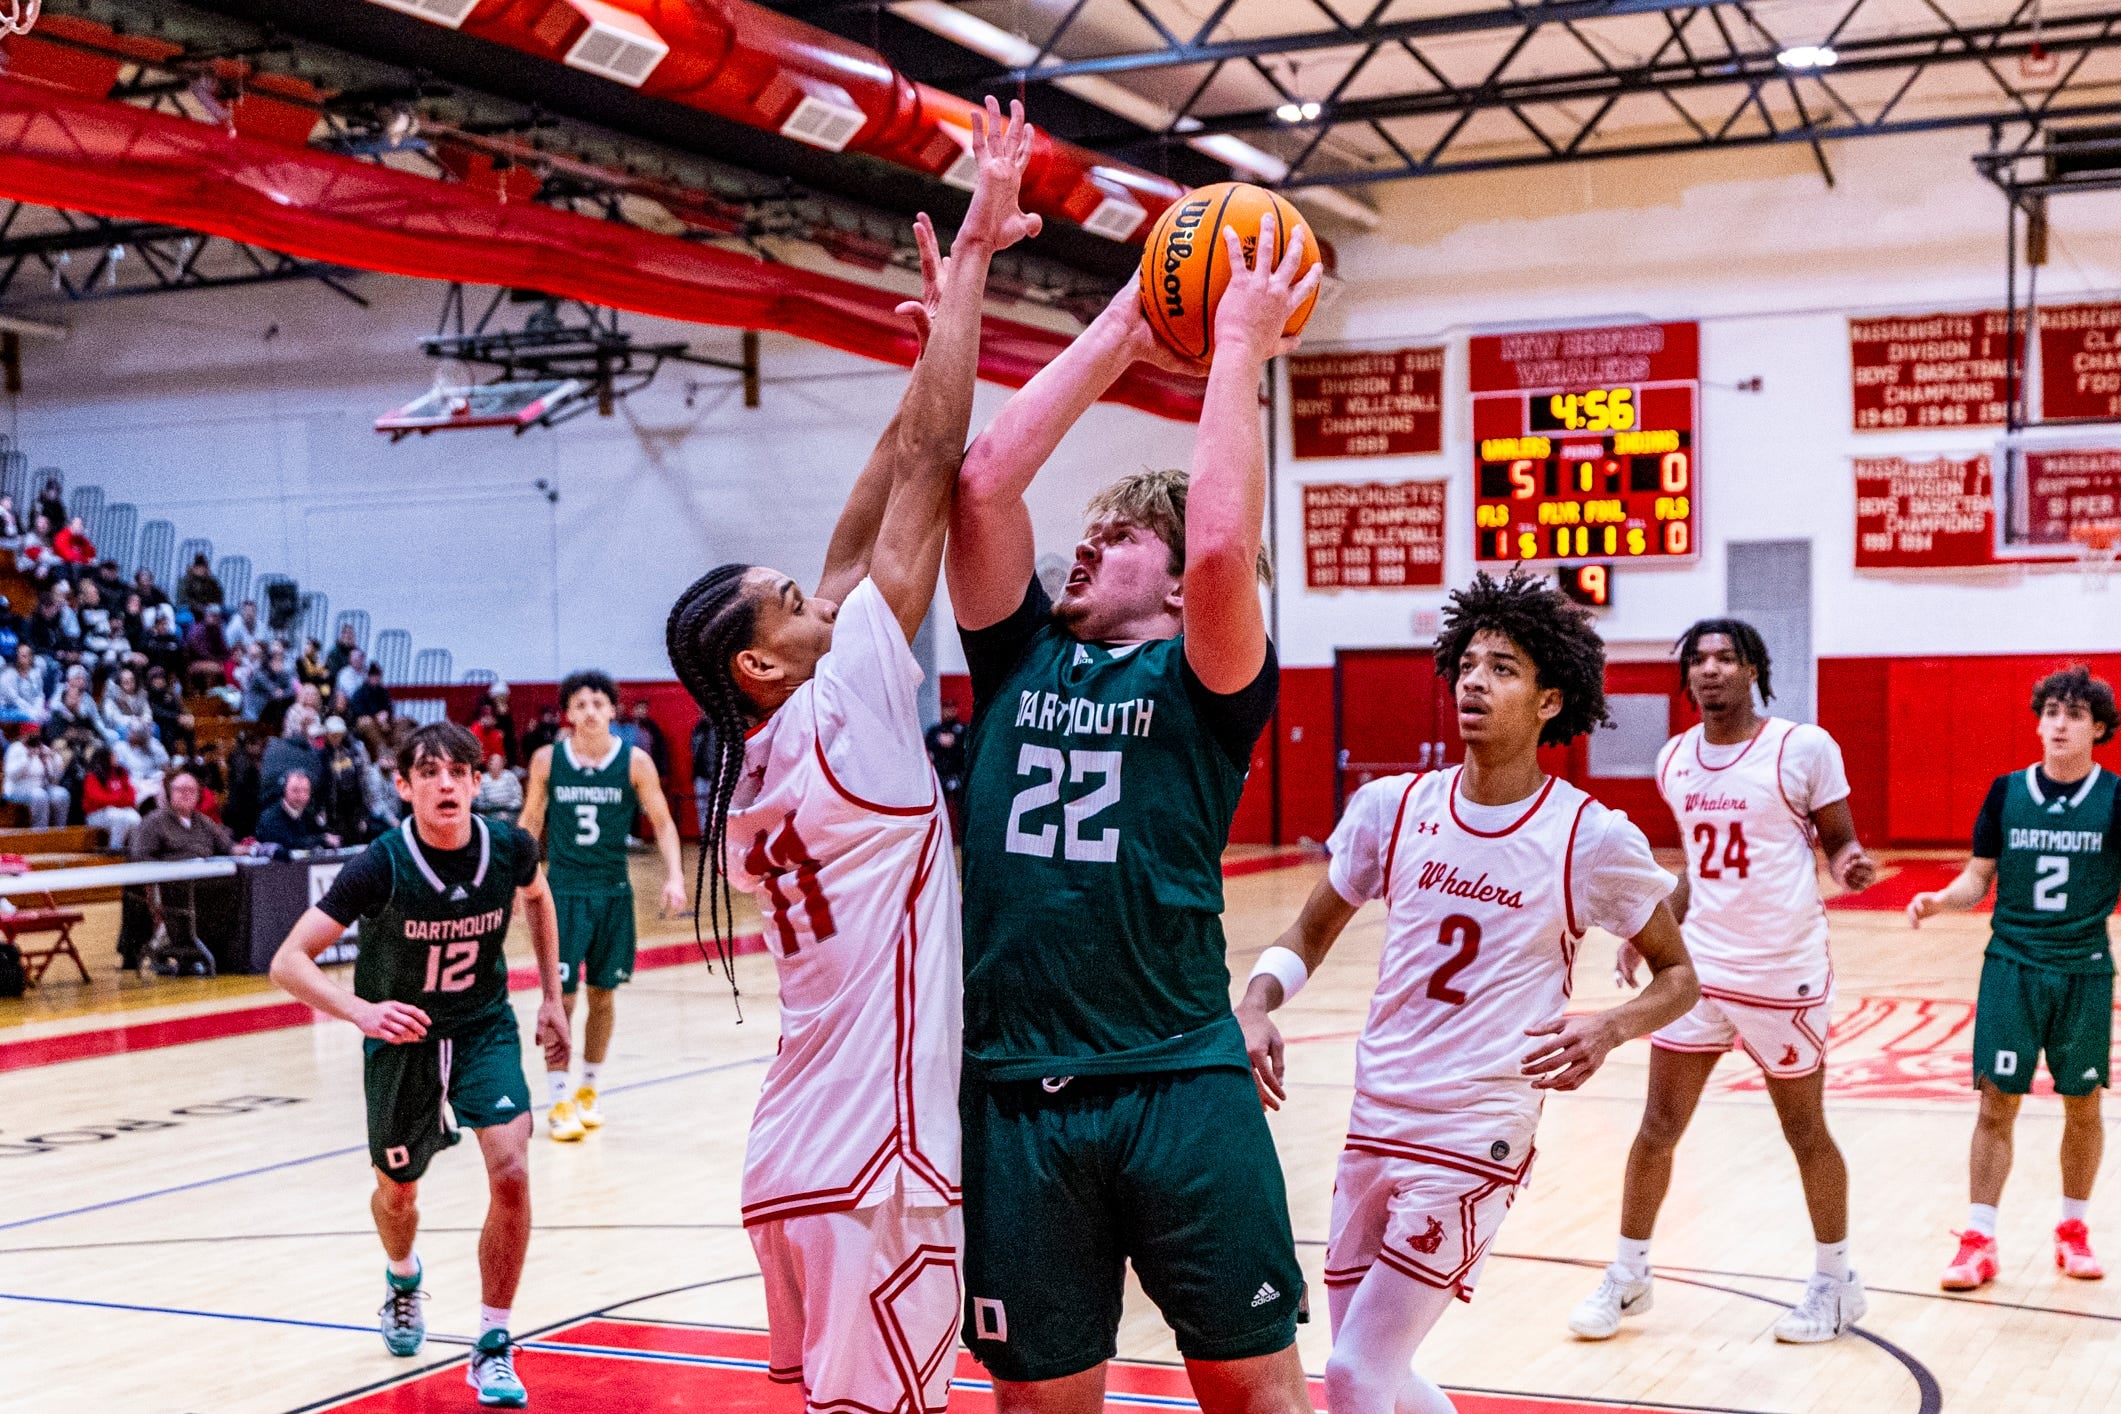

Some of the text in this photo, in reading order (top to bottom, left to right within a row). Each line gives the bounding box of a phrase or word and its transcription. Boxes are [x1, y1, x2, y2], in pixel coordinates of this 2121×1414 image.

[1164, 199, 1211, 318] Wilson
[1887, 340, 1971, 362] DIVISION
[1855, 357, 2023, 385] BOYS BASKETBAL
[1346, 394, 1440, 414] VOLLEYBALL
[1551, 388, 1635, 431] 4:56
[1883, 381, 1995, 406] CHAMPIONS
[1320, 414, 1414, 434] CHAMPIONS
[1511, 460, 1535, 499] 5
[1580, 461, 1593, 492] 1
[1661, 452, 1688, 492] 0
[1358, 505, 1440, 525] CHAMPIONS
[1353, 525, 1441, 545] VOLLEYBALL
[1665, 521, 1688, 554] 0
[1577, 564, 1606, 604] 9
[555, 786, 622, 804] DARTMOUTH
[1006, 743, 1122, 863] 22
[1685, 792, 1748, 813] Whalers
[575, 805, 600, 846] 3
[2010, 828, 2103, 852] DARTMOUTH
[1693, 822, 1749, 879] 24
[745, 808, 838, 959] 11
[1418, 861, 1524, 909] Whalers
[2034, 855, 2070, 912] 2
[405, 908, 503, 940] DARTMOUTH
[422, 941, 479, 993] 12
[1426, 913, 1482, 1005] 2
[1994, 1050, 2018, 1076] D
[386, 1146, 409, 1169] D
[1251, 1291, 1280, 1307] adidas
[973, 1296, 1008, 1343] D
